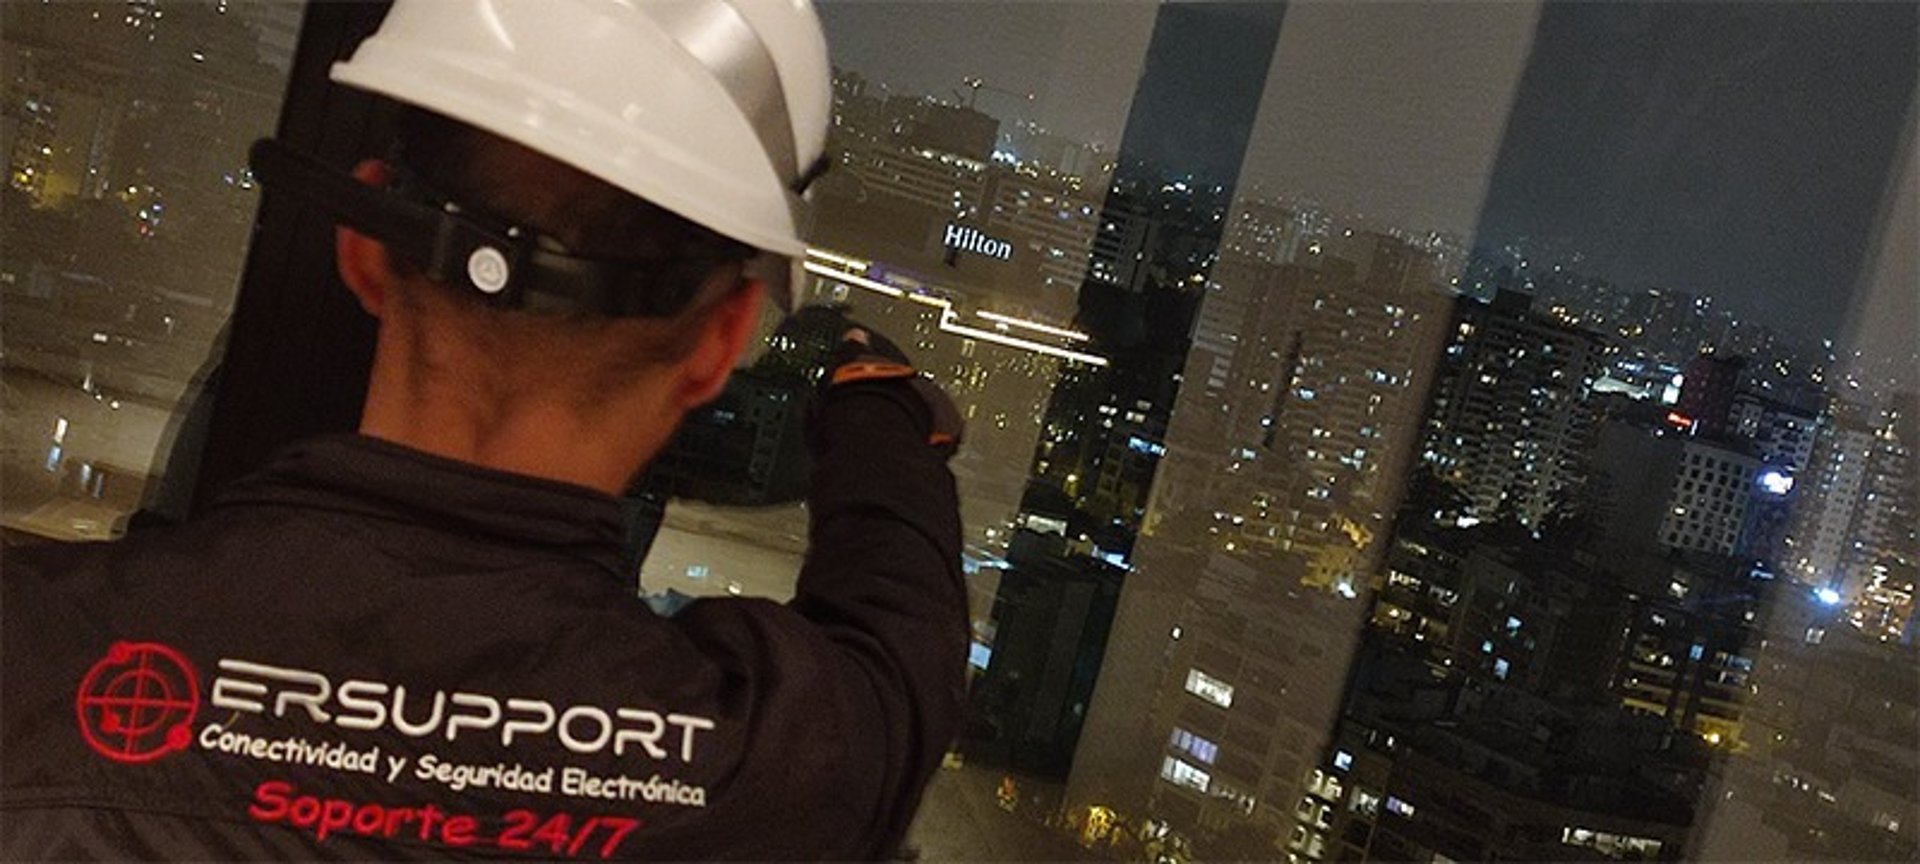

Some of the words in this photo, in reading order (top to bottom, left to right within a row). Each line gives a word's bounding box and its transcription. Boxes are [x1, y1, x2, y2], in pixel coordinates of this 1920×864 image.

[944, 224, 1012, 260] Hilton
[212, 658, 715, 762] ERSUPPORT
[199, 723, 379, 774] Conectividad
[387, 755, 406, 783] y
[415, 754, 553, 792] Seguridad
[561, 767, 706, 807] Electrónica
[249, 780, 478, 847] Soporte
[497, 808, 642, 860] 24/7
